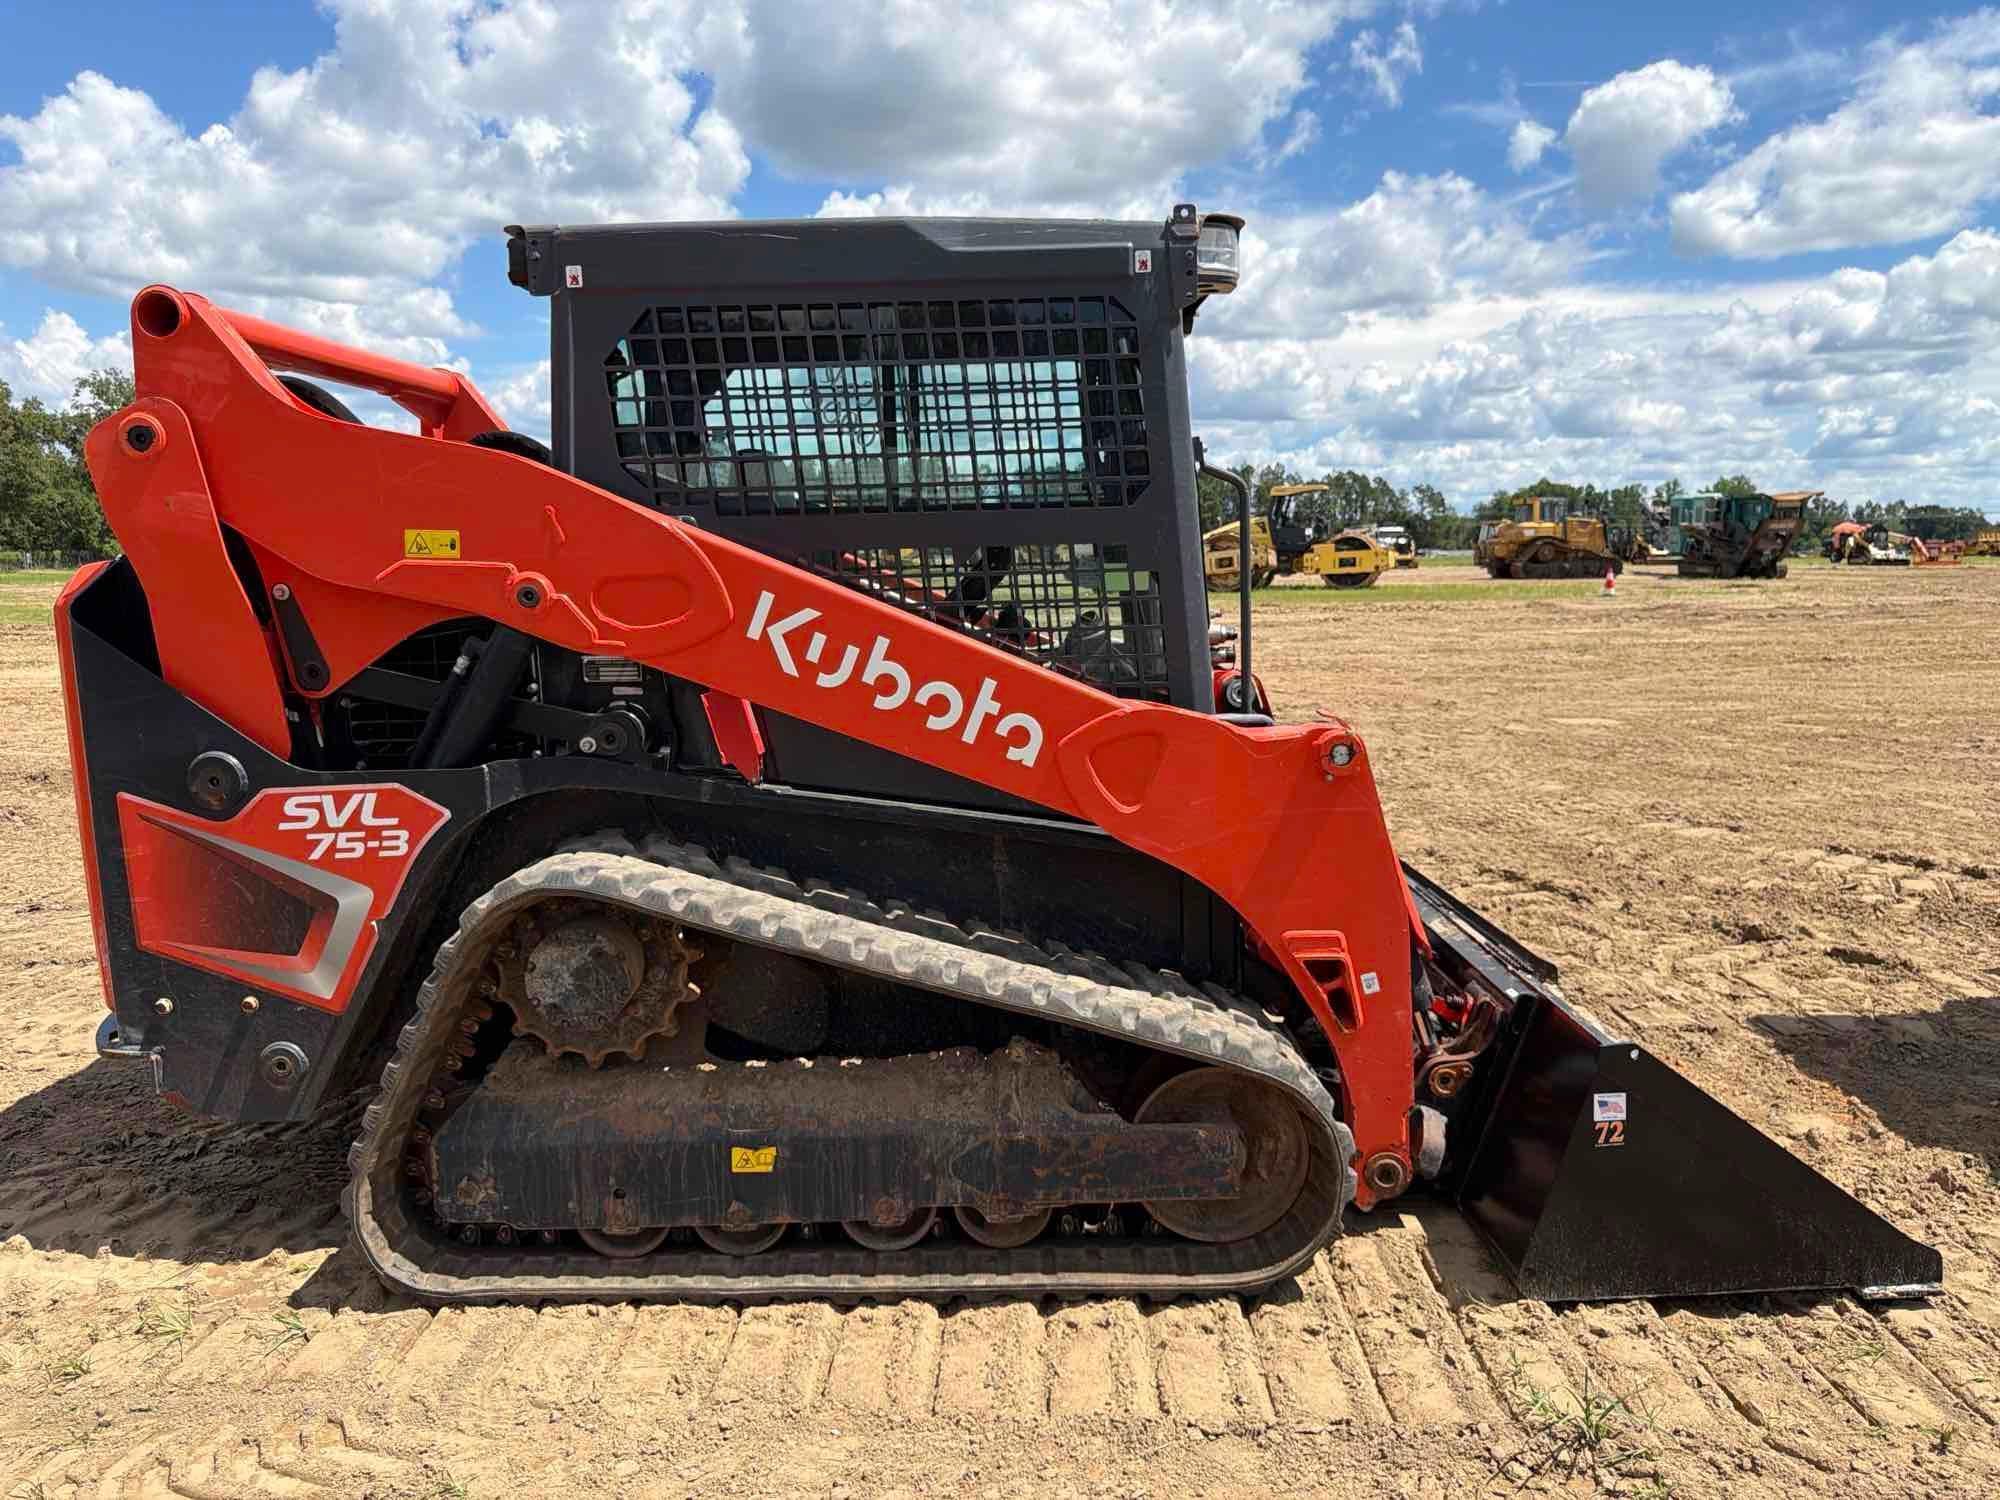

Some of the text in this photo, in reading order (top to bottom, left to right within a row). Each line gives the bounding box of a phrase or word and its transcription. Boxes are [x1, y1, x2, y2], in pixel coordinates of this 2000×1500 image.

[746, 590, 1044, 769] Kubota
[278, 792, 400, 831] SVL
[306, 829, 409, 860] 75-3
[1594, 1120, 1625, 1145] 72
